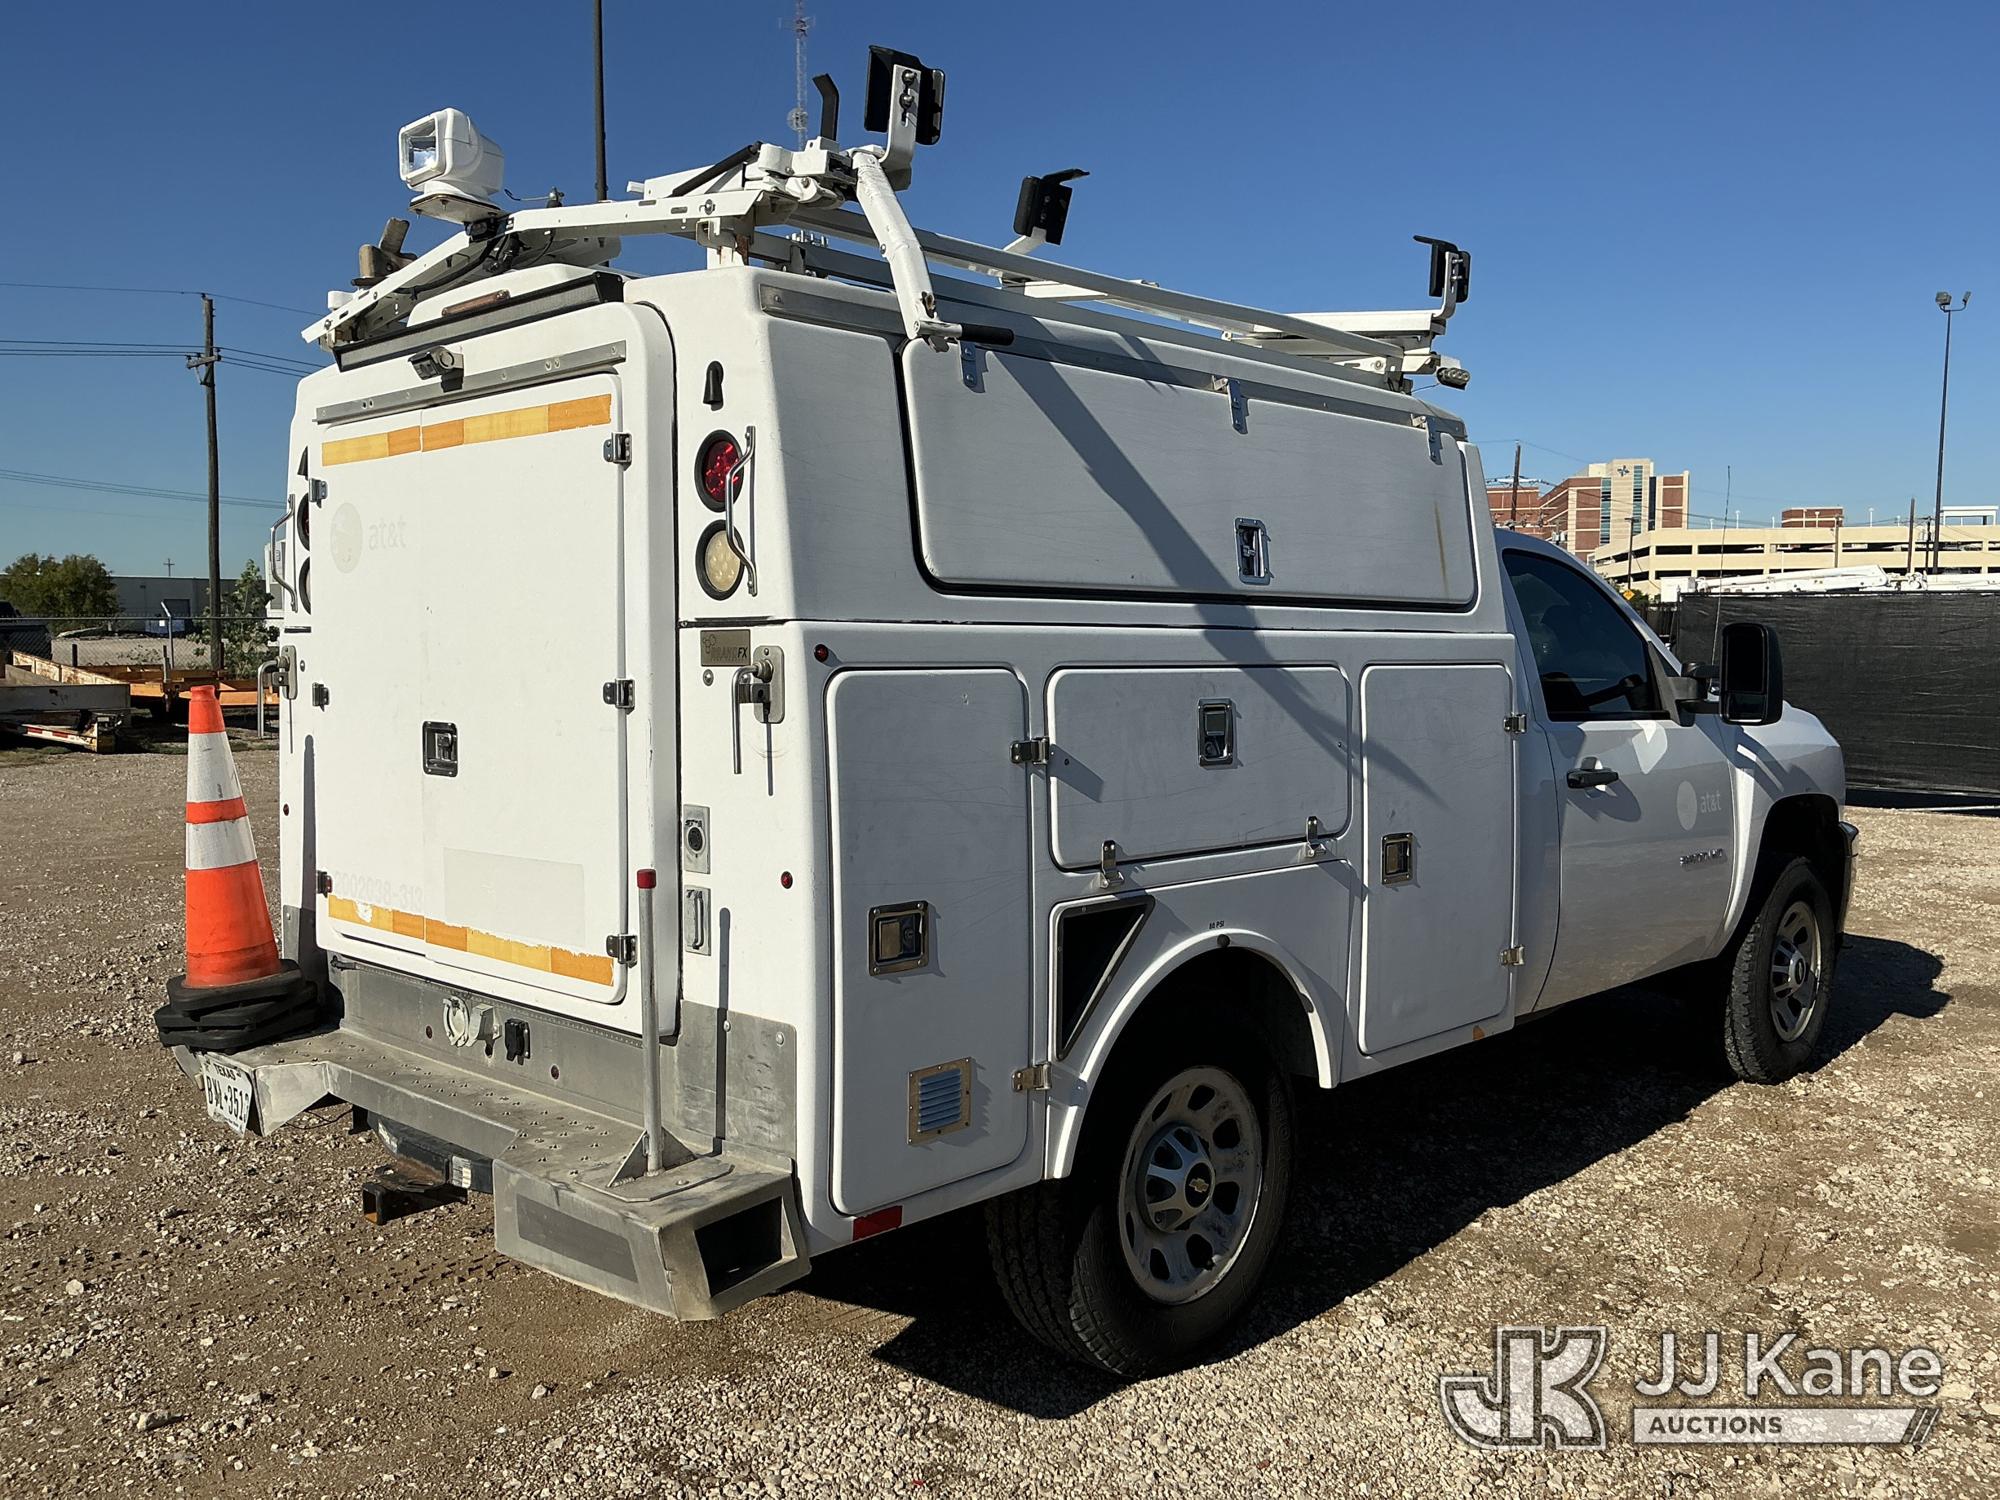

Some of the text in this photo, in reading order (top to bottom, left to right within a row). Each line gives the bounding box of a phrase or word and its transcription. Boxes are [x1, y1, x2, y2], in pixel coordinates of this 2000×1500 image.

[368, 515, 407, 551] at&t
[1700, 791, 1722, 813] at&t
[213, 1063, 237, 1081] TEXAS
